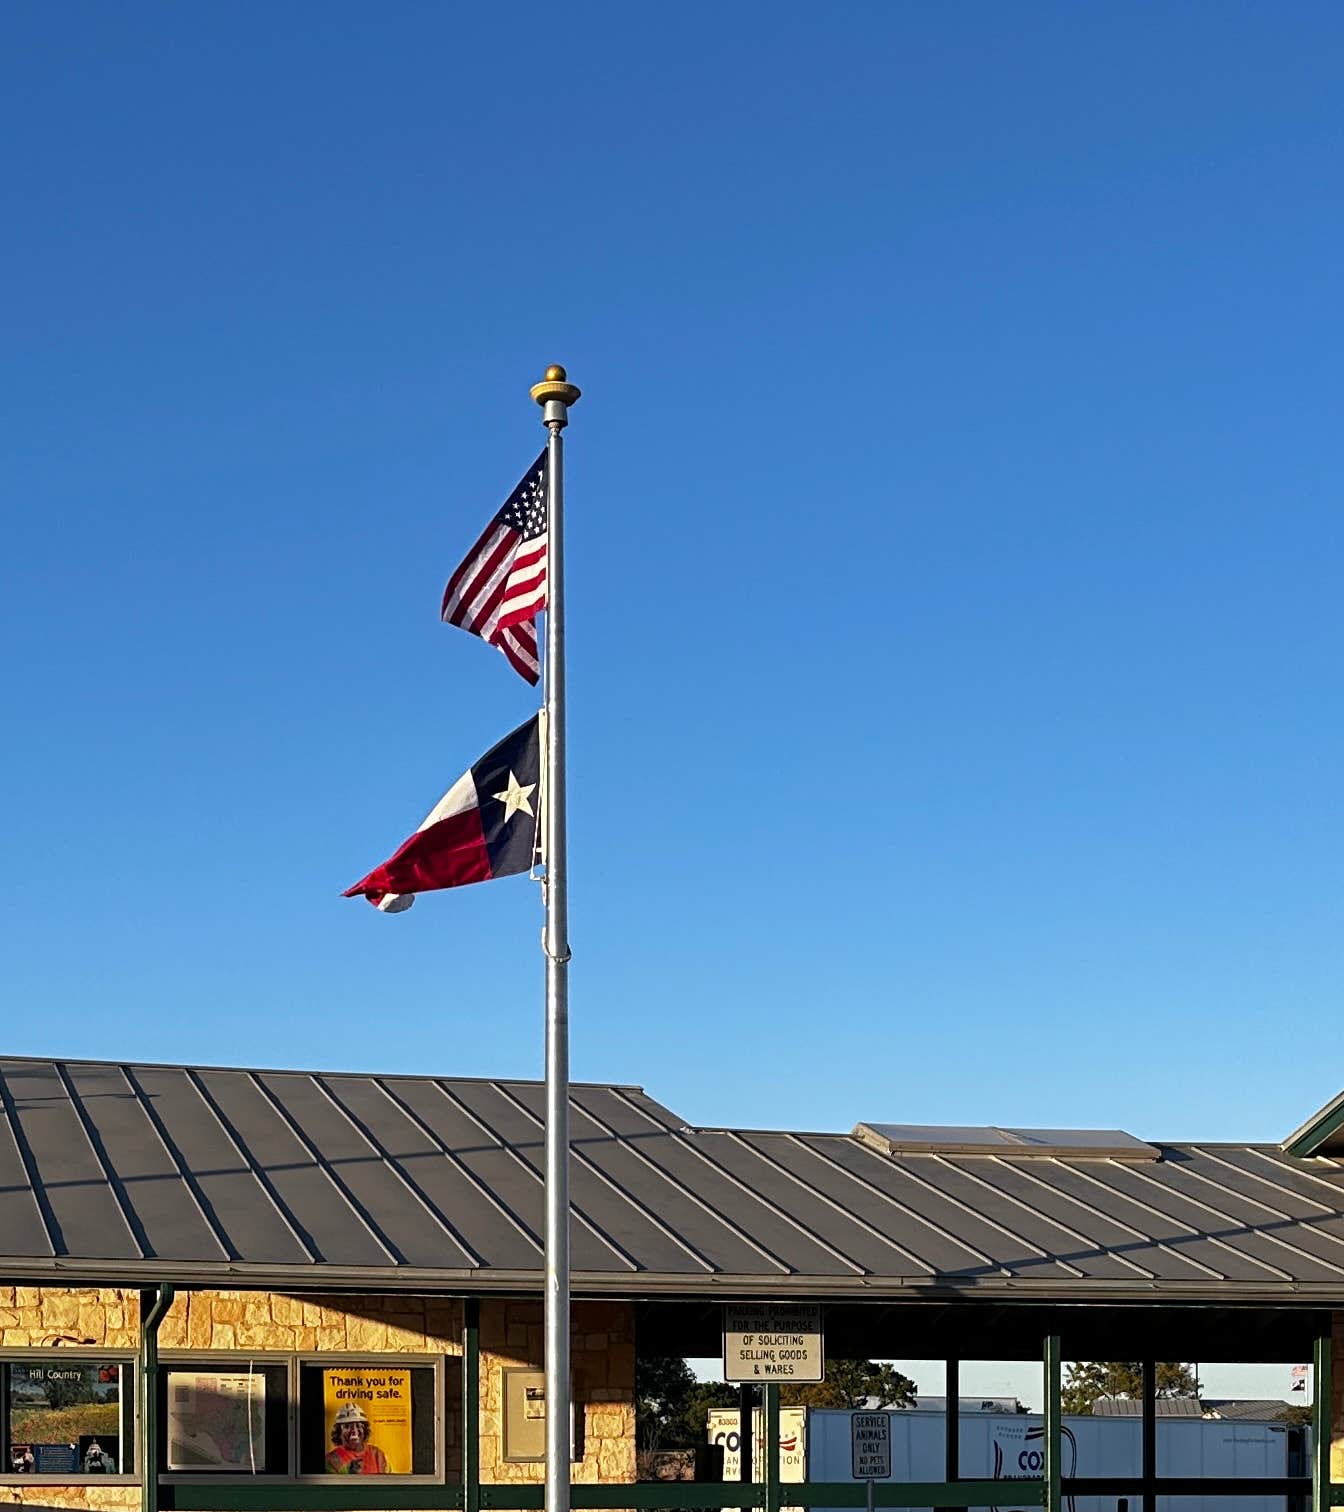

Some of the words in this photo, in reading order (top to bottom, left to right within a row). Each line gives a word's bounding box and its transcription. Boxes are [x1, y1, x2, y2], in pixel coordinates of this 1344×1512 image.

[732, 1320, 749, 1330] FOR
[754, 1320, 769, 1331] THE
[774, 1320, 813, 1331] PURPOSE
[742, 1335, 754, 1345] OF
[758, 1335, 804, 1346] SOLICITING
[739, 1350, 775, 1360] SELLING
[778, 1350, 808, 1360] GOODS
[753, 1364, 760, 1374] &
[764, 1364, 794, 1374] WARES
[29, 1369, 44, 1379] Hill
[47, 1369, 81, 1381] Country
[330, 1376, 363, 1387] Thank
[365, 1378, 386, 1388] you
[389, 1376, 404, 1386] for
[336, 1389, 373, 1400] driving
[376, 1389, 402, 1399] safe.
[856, 1416, 887, 1427] SERVICE
[856, 1430, 887, 1440] ANIMALS
[862, 1442, 881, 1453] ONLY
